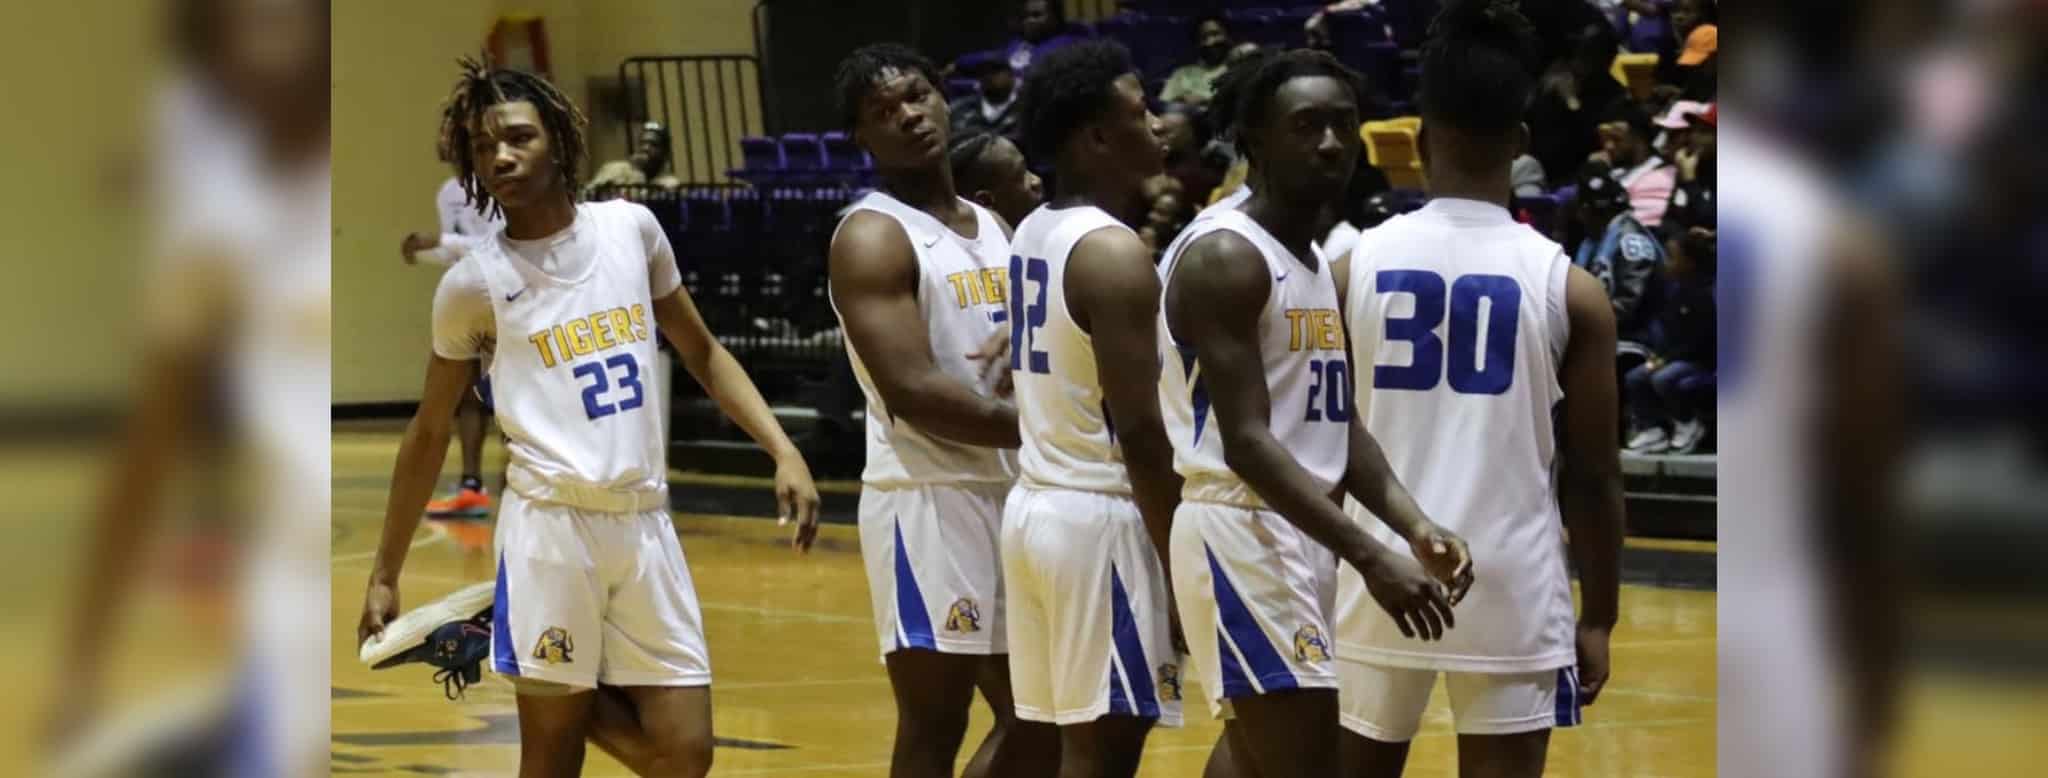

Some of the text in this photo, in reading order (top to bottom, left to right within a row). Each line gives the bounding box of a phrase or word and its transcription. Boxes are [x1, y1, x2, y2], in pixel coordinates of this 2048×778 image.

[529, 303, 647, 368] TIGERS
[1373, 269, 1521, 395] 30
[573, 353, 643, 421] 23
[1304, 359, 1351, 422] 20
